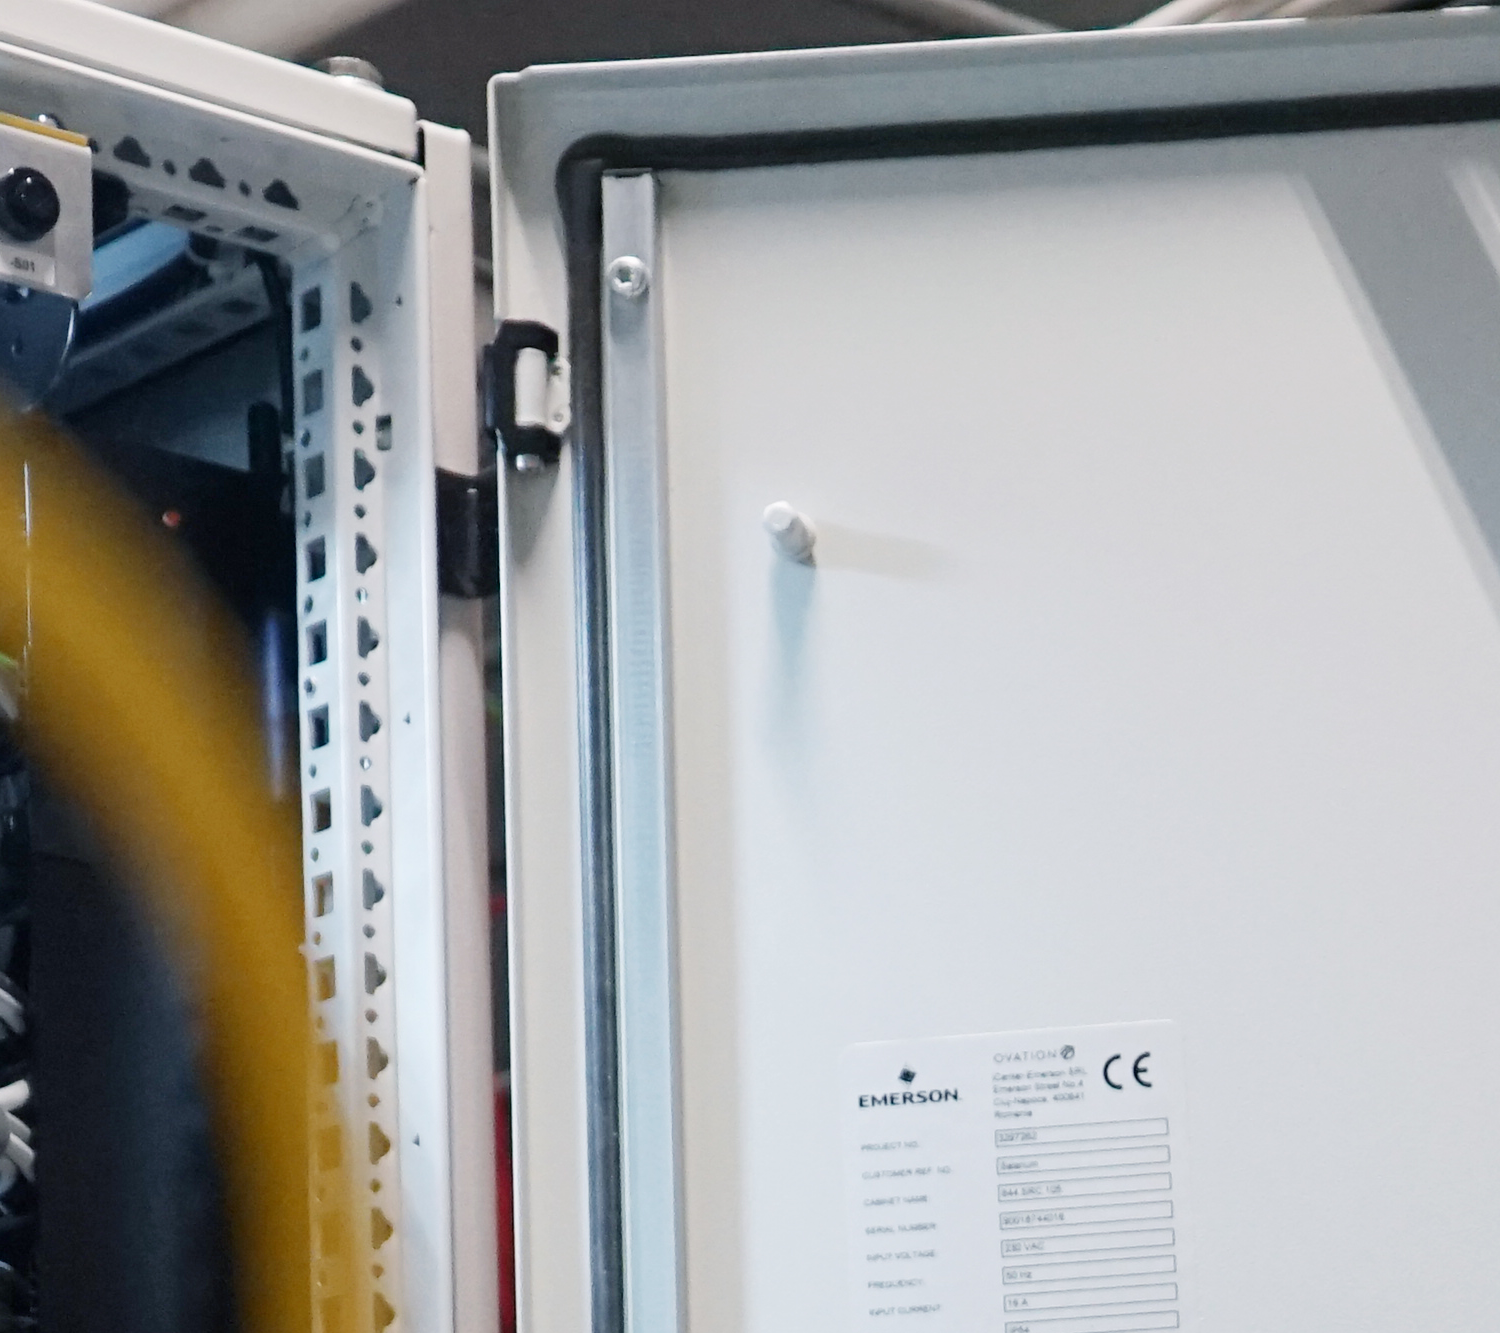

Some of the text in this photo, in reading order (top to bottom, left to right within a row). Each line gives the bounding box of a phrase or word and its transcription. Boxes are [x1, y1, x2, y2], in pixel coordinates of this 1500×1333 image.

[993, 1049, 1058, 1063] OVATION
[1102, 1051, 1153, 1090] CE
[858, 1088, 959, 1108] EMERSON
[860, 1141, 902, 1151] PROJECT
[861, 1168, 913, 1180] CUSTOMER
[866, 1253, 892, 1262] INPUT
[869, 1306, 895, 1316] INPUT
